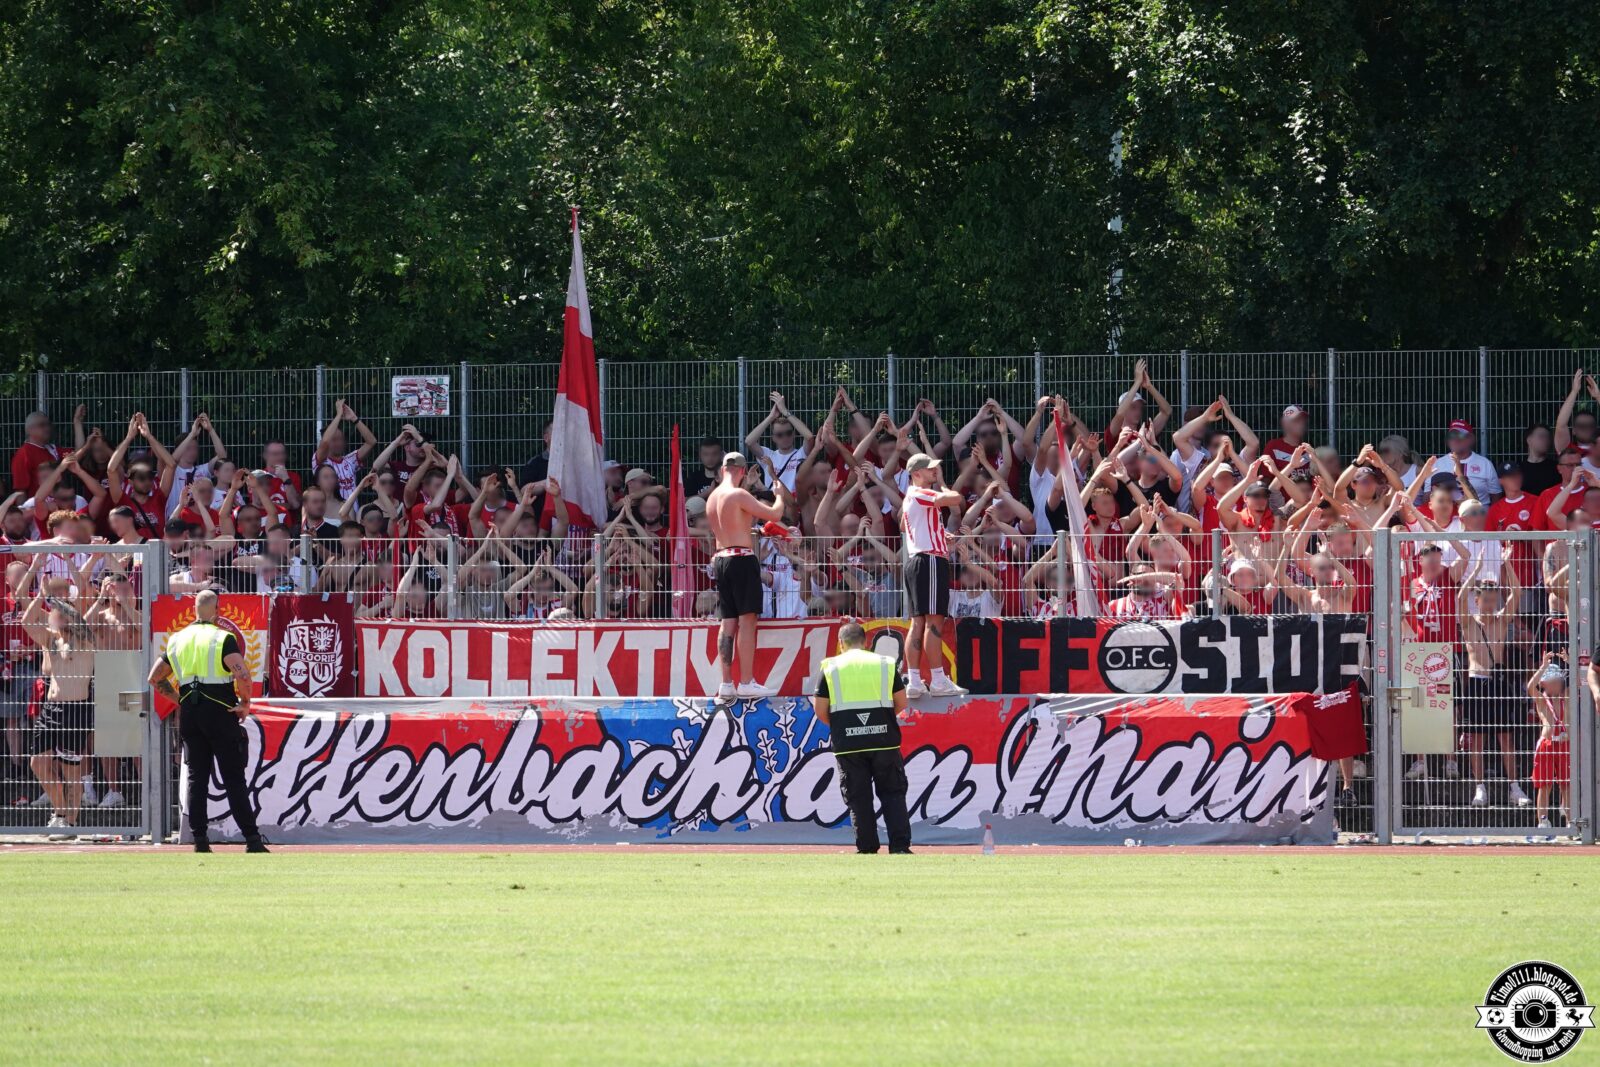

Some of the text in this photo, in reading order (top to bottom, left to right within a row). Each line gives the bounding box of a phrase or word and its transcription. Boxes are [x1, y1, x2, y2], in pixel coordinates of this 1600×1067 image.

[286, 651, 336, 663] KATEGORIE
[362, 626, 830, 698] KOLLEKTIV 71
[956, 614, 1368, 695] OFF O.F.C. SIDE
[845, 724, 888, 737] SICHERHEITSDIENST
[994, 700, 1328, 825] Main
